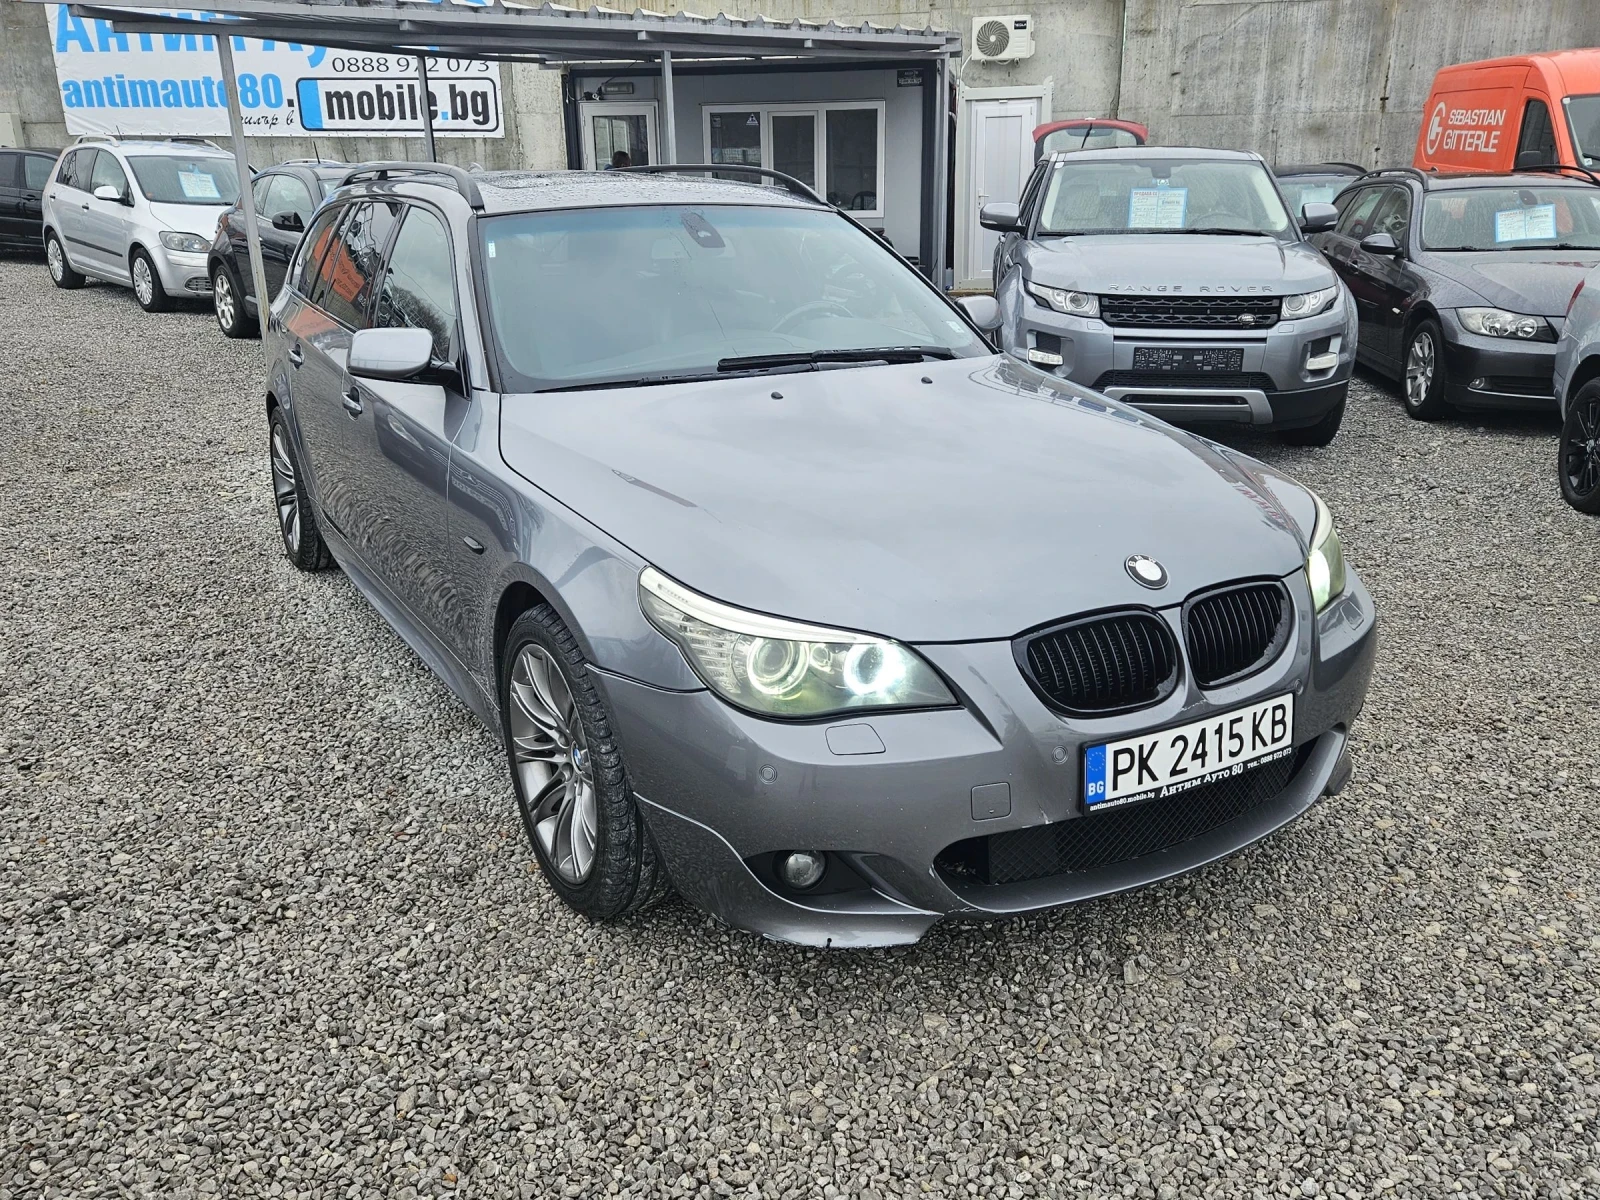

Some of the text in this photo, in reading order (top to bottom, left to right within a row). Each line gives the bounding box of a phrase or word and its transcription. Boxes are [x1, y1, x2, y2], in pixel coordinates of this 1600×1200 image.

[332, 57, 389, 73] 0888
[325, 83, 491, 126] mobile.bg
[1447, 109, 1506, 126] SEBASTIAN
[1443, 129, 1501, 153] GITTERLE
[1108, 284, 1273, 293] RANGE ROVER
[1112, 703, 1287, 792] PK 2415 KB
[1260, 754, 1273, 764] 0888
[1088, 780, 1104, 796] BG
[1159, 762, 1244, 798] Антим Ауто 80
[1089, 791, 1156, 811] antimauto80.mobile.bg
